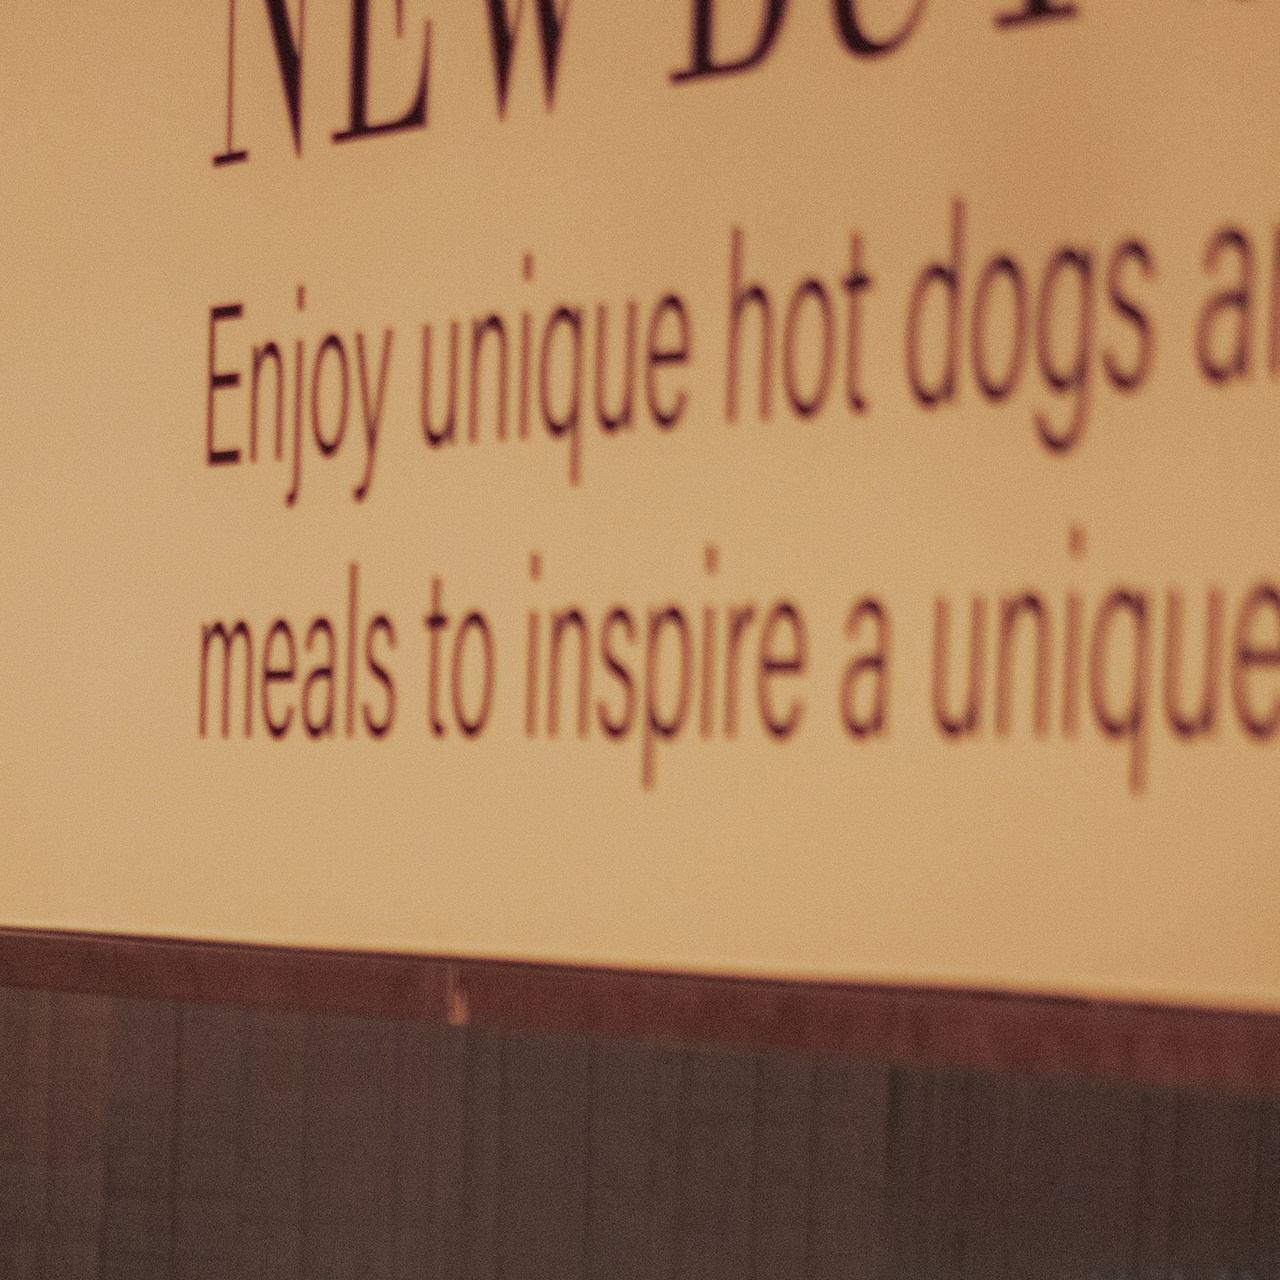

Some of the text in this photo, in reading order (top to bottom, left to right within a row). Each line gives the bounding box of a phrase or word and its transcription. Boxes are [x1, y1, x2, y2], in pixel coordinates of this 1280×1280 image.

[206, 196, 1280, 508] Enjoy unique hot dogs a
[199, 526, 1280, 794] meals to inspire a unique
